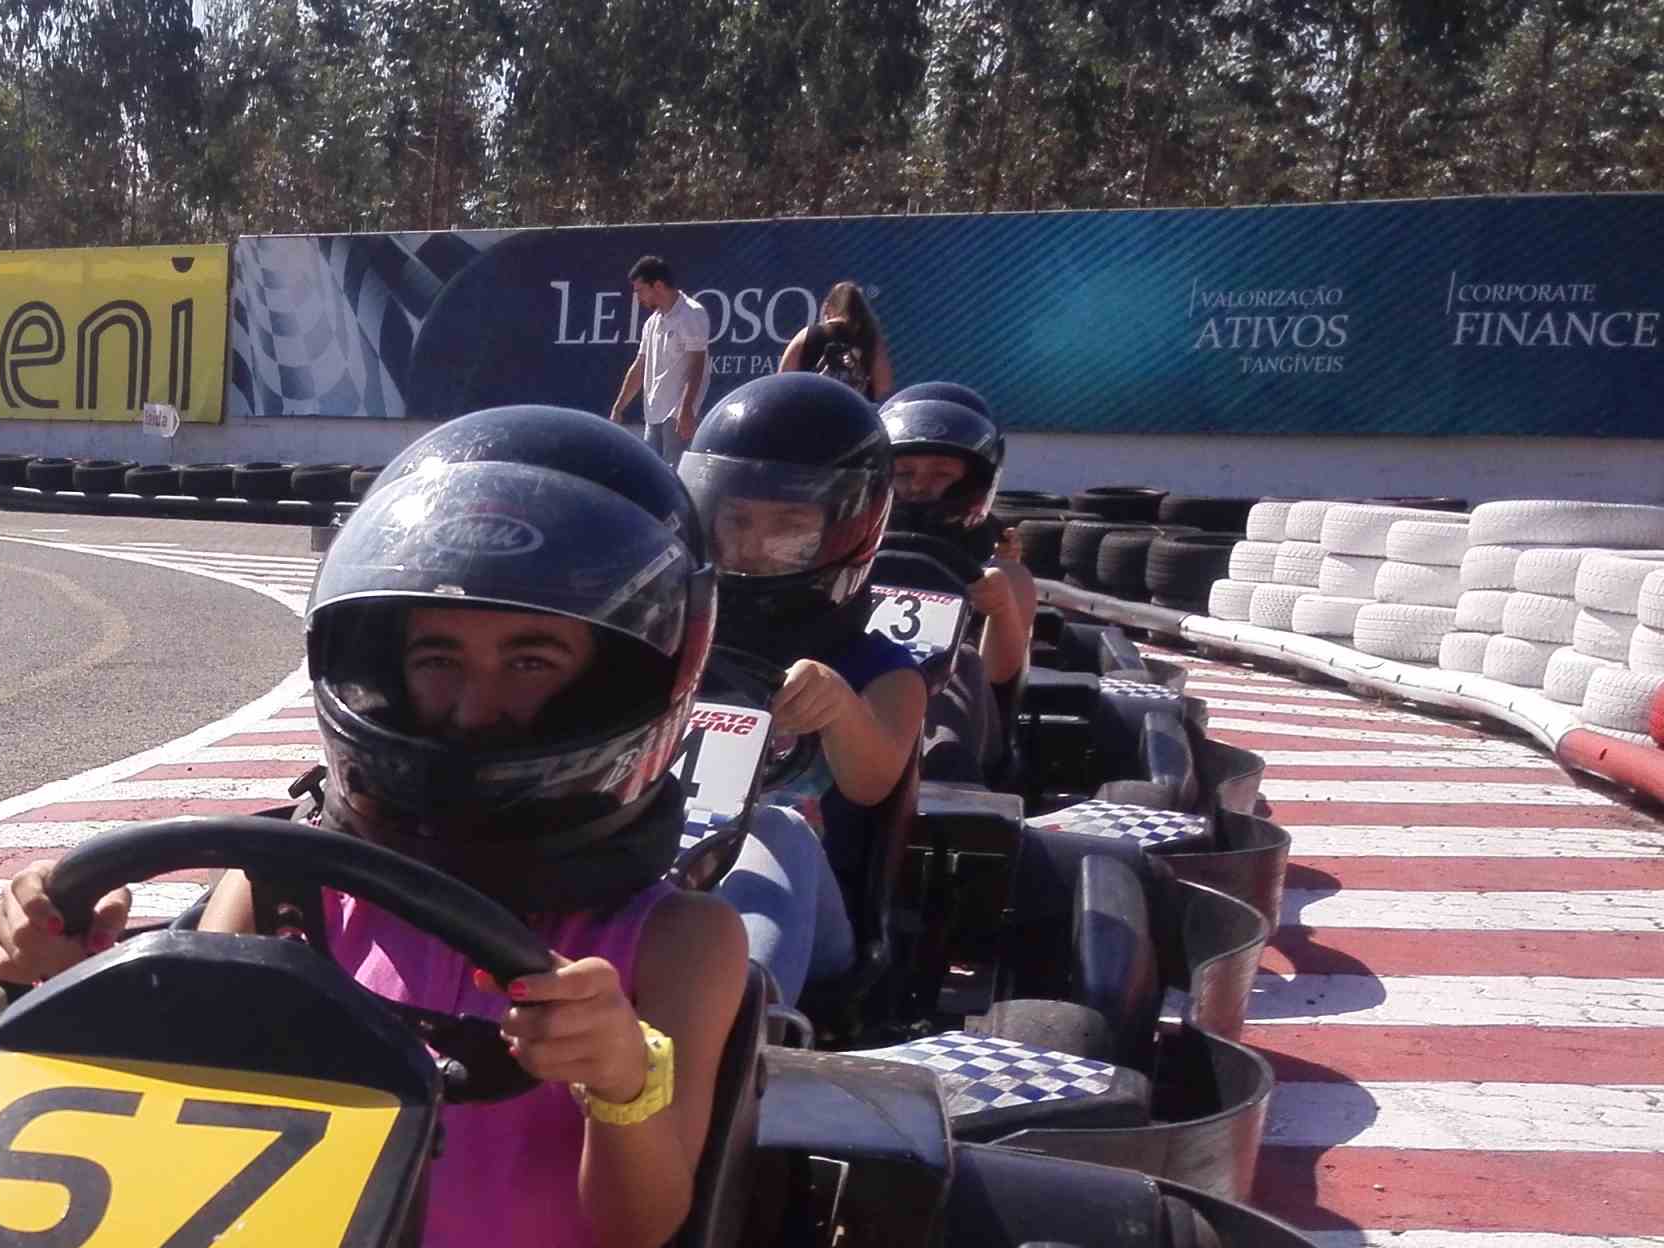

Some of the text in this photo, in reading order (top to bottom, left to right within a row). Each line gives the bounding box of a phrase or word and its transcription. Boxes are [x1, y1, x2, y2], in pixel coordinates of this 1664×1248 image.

[1200, 286, 1344, 308] VALORIZAÇÃO
[1457, 283, 1598, 303] CORPORATE
[0, 257, 194, 411] eni
[1193, 314, 1350, 351] ATIVOS
[1452, 312, 1661, 347] FINANCE
[1239, 354, 1344, 375] TANGÍVEIS
